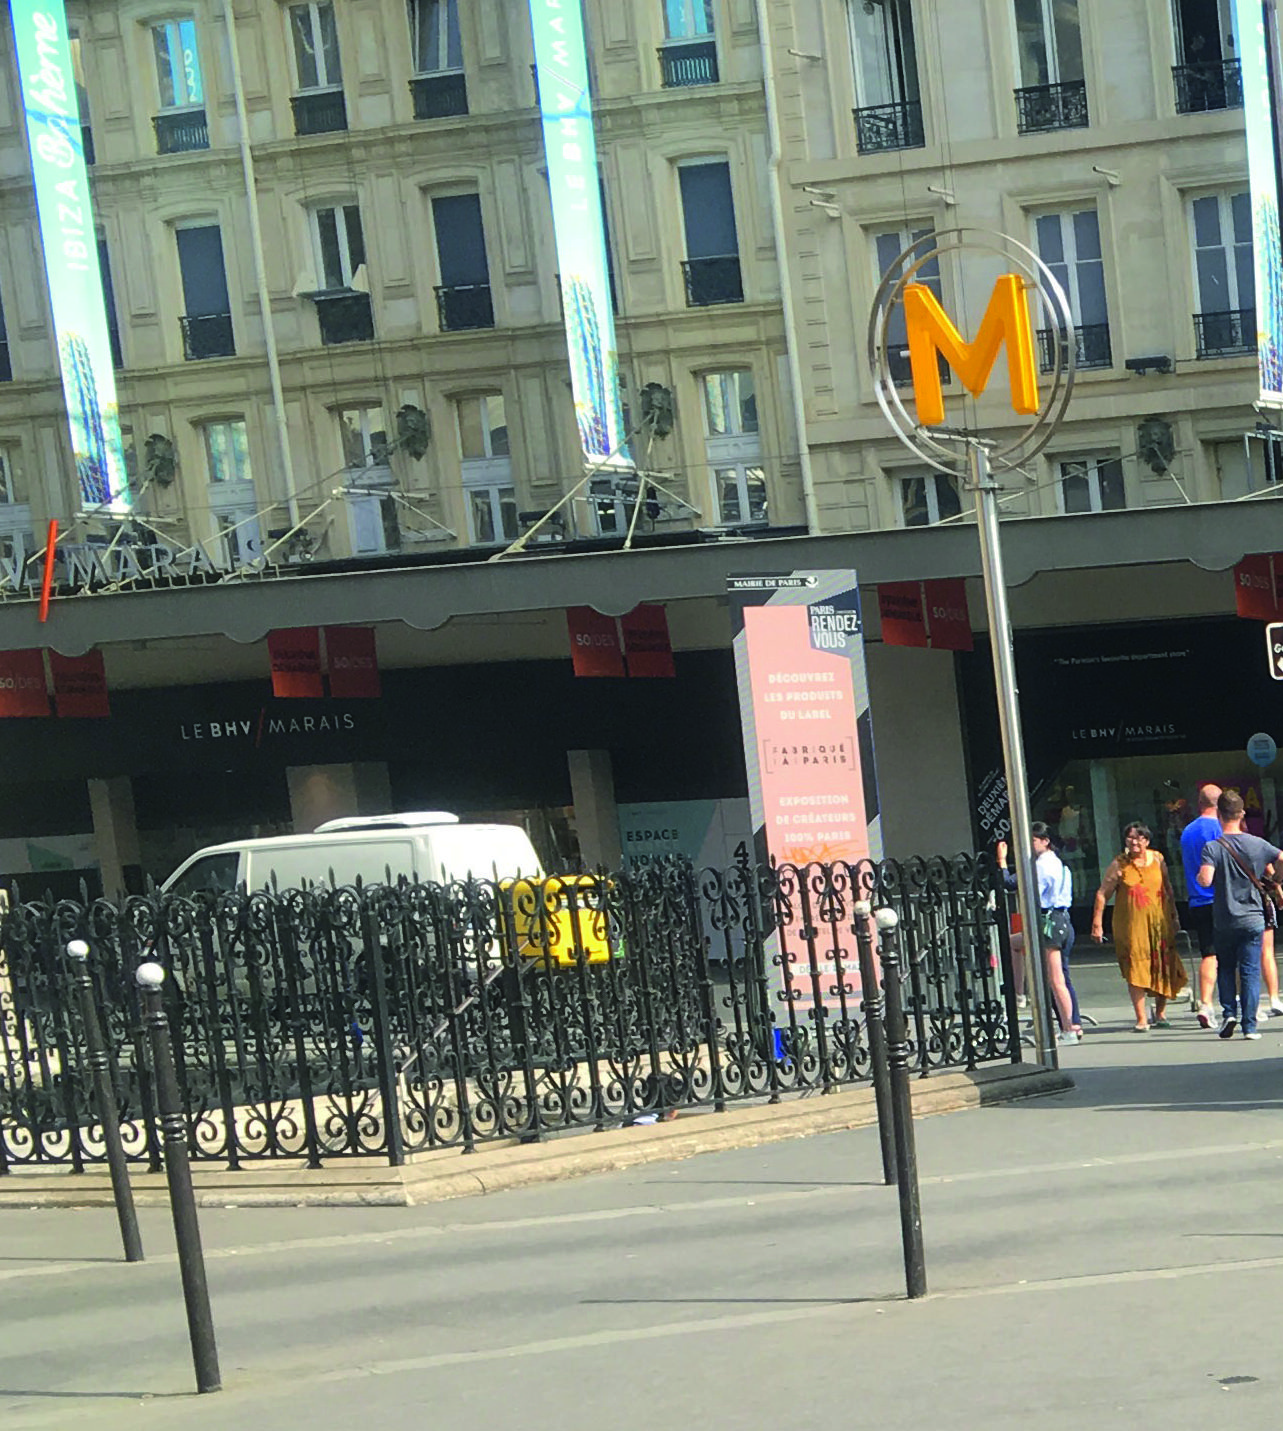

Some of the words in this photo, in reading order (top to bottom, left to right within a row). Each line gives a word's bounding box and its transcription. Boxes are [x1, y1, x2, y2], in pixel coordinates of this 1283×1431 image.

[565, 174, 588, 210] LE
[54, 179, 89, 271] IBIZA
[904, 274, 1040, 426] M
[765, 579, 776, 587] DE
[778, 579, 802, 587] PARIS
[810, 605, 834, 615] PARIS
[811, 614, 861, 632] RENDEZ-
[813, 631, 846, 648] VOUS
[768, 672, 834, 684] DÉCOUVREZ
[764, 692, 783, 702] LES
[780, 710, 796, 720] DU
[798, 709, 832, 720] LABEL
[180, 723, 202, 740] LE
[269, 713, 355, 734] MARAIS
[1072, 729, 1087, 739] LE
[778, 795, 849, 807] EXPOSITION
[978, 776, 1007, 815] DEUXIÈ
[776, 814, 789, 825] DE
[792, 811, 856, 824] CRÉATEURS
[626, 829, 679, 842] ESPACE
[784, 832, 814, 842] 100%
[817, 831, 851, 841] PARIS
